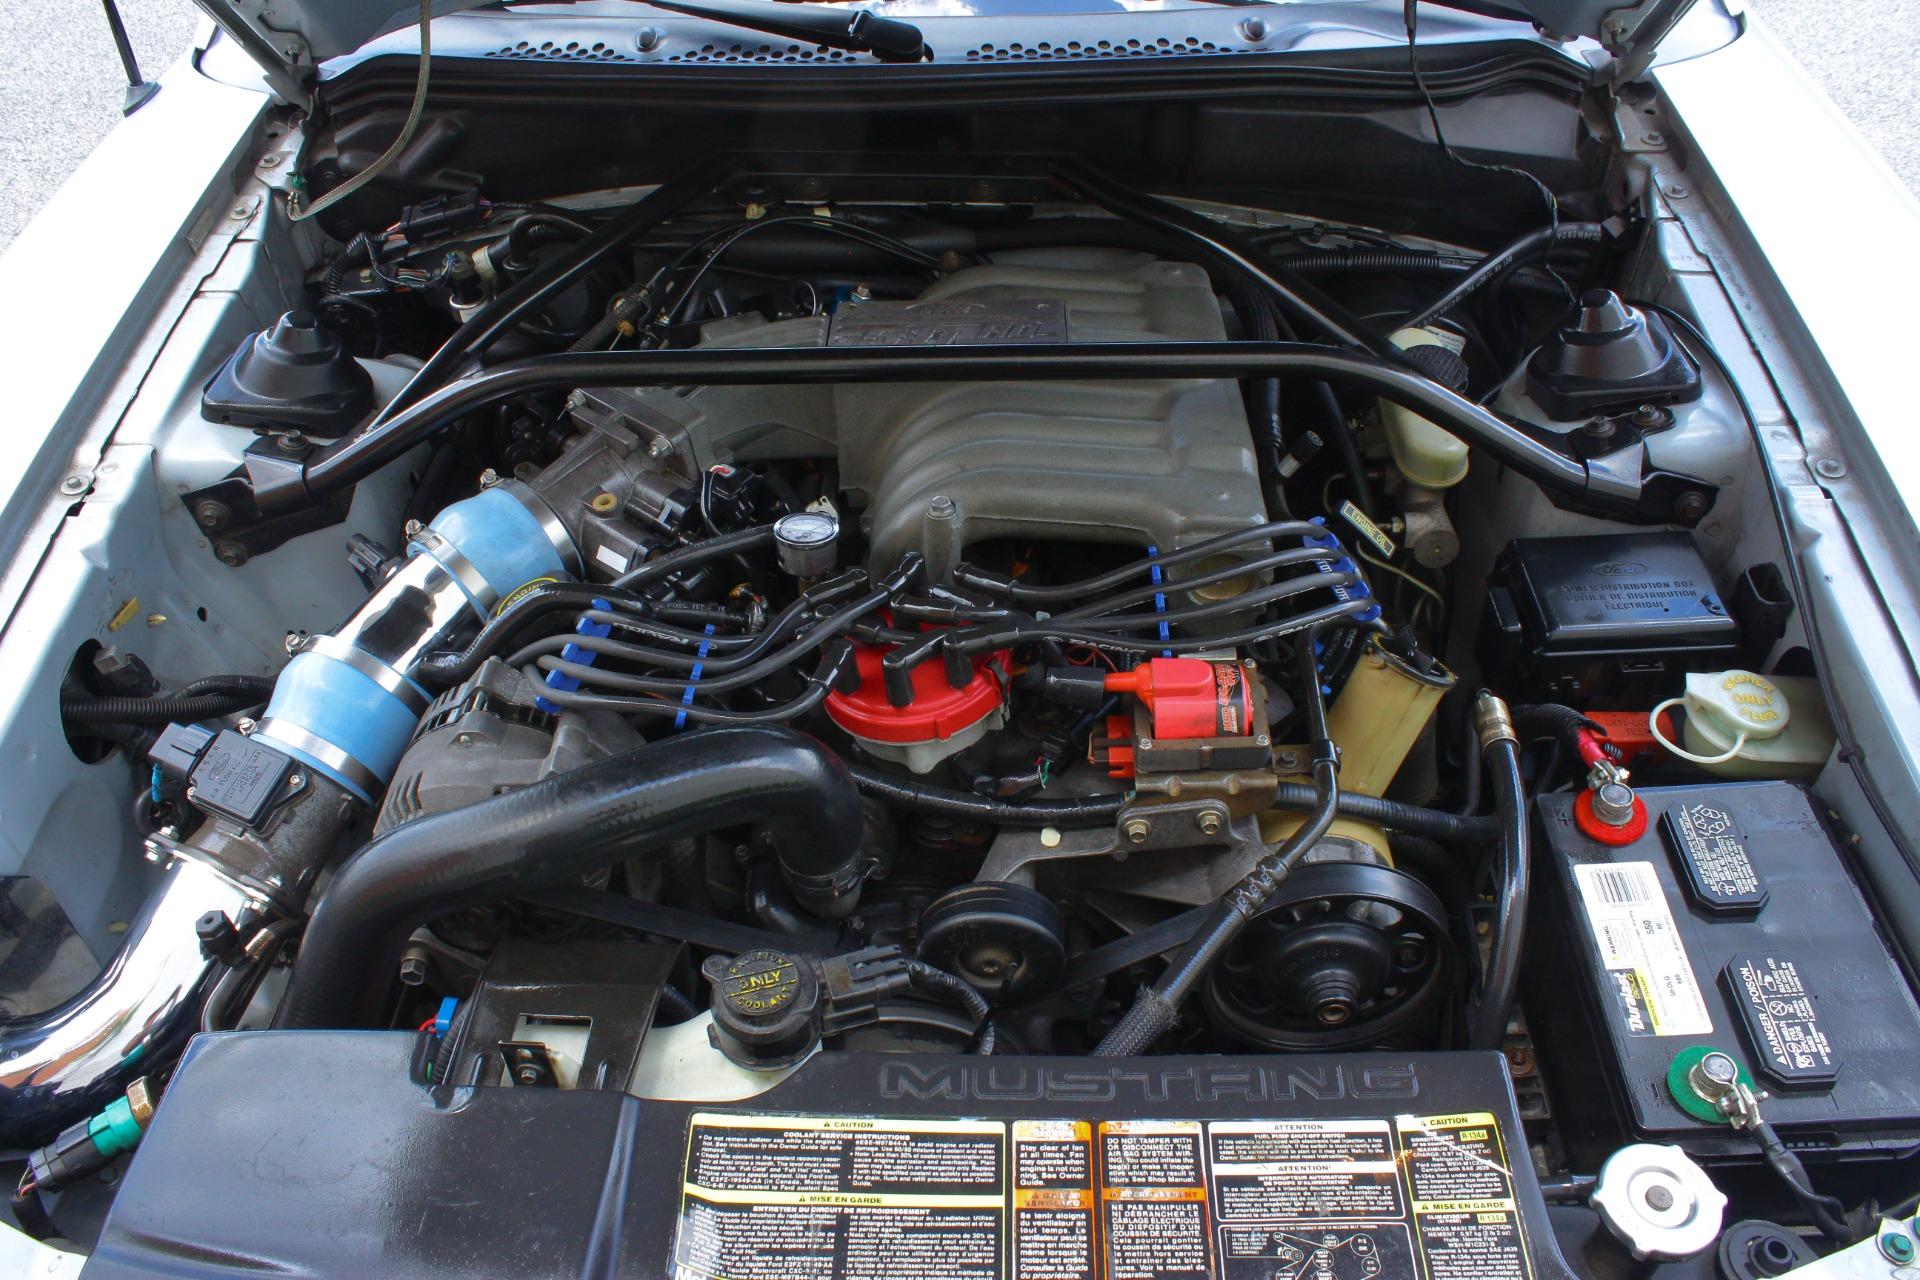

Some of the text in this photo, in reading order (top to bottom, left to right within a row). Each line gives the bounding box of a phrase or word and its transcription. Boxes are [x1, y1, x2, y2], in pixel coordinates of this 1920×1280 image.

[1351, 509, 1387, 548] ENGINE OIL
[1601, 582, 1670, 591] DISTRIBUTION
[1627, 590, 1697, 599] DISTRIBUTION
[1733, 693, 1772, 705] ONLY
[1643, 920, 1655, 935] 550
[1604, 925, 1616, 954] WARNING
[739, 970, 781, 989] ONLY
[1740, 967, 1763, 1003] POISON
[1626, 973, 1641, 1000] GOLD
[737, 986, 789, 1009] COOLANT
[1613, 972, 1645, 1032] Duralast
[1786, 1004, 1795, 1013] NO
[1759, 1011, 1783, 1055] DANGER
[1779, 1021, 1792, 1042] SHIELD
[1788, 1027, 1799, 1040] EYES
[1794, 1025, 1811, 1053] EXPLOSIVE
[1806, 1035, 1817, 1053] GASES
[879, 1062, 1417, 1100] MUSTANG
[834, 1121, 874, 1129] CAUTION
[1430, 1117, 1468, 1126] CAUTION
[1461, 1130, 1486, 1139] R-134a
[1020, 1144, 1037, 1152] Stay
[1043, 1151, 1066, 1159] times.
[1020, 1165, 1046, 1173] engine
[1020, 1172, 1039, 1180] ning.
[1056, 1211, 1086, 1221] éloigné
[1041, 1227, 1070, 1235] temps.
[1060, 1235, 1077, 1243] peut
[1020, 1271, 1082, 1280] du propriétaire.
